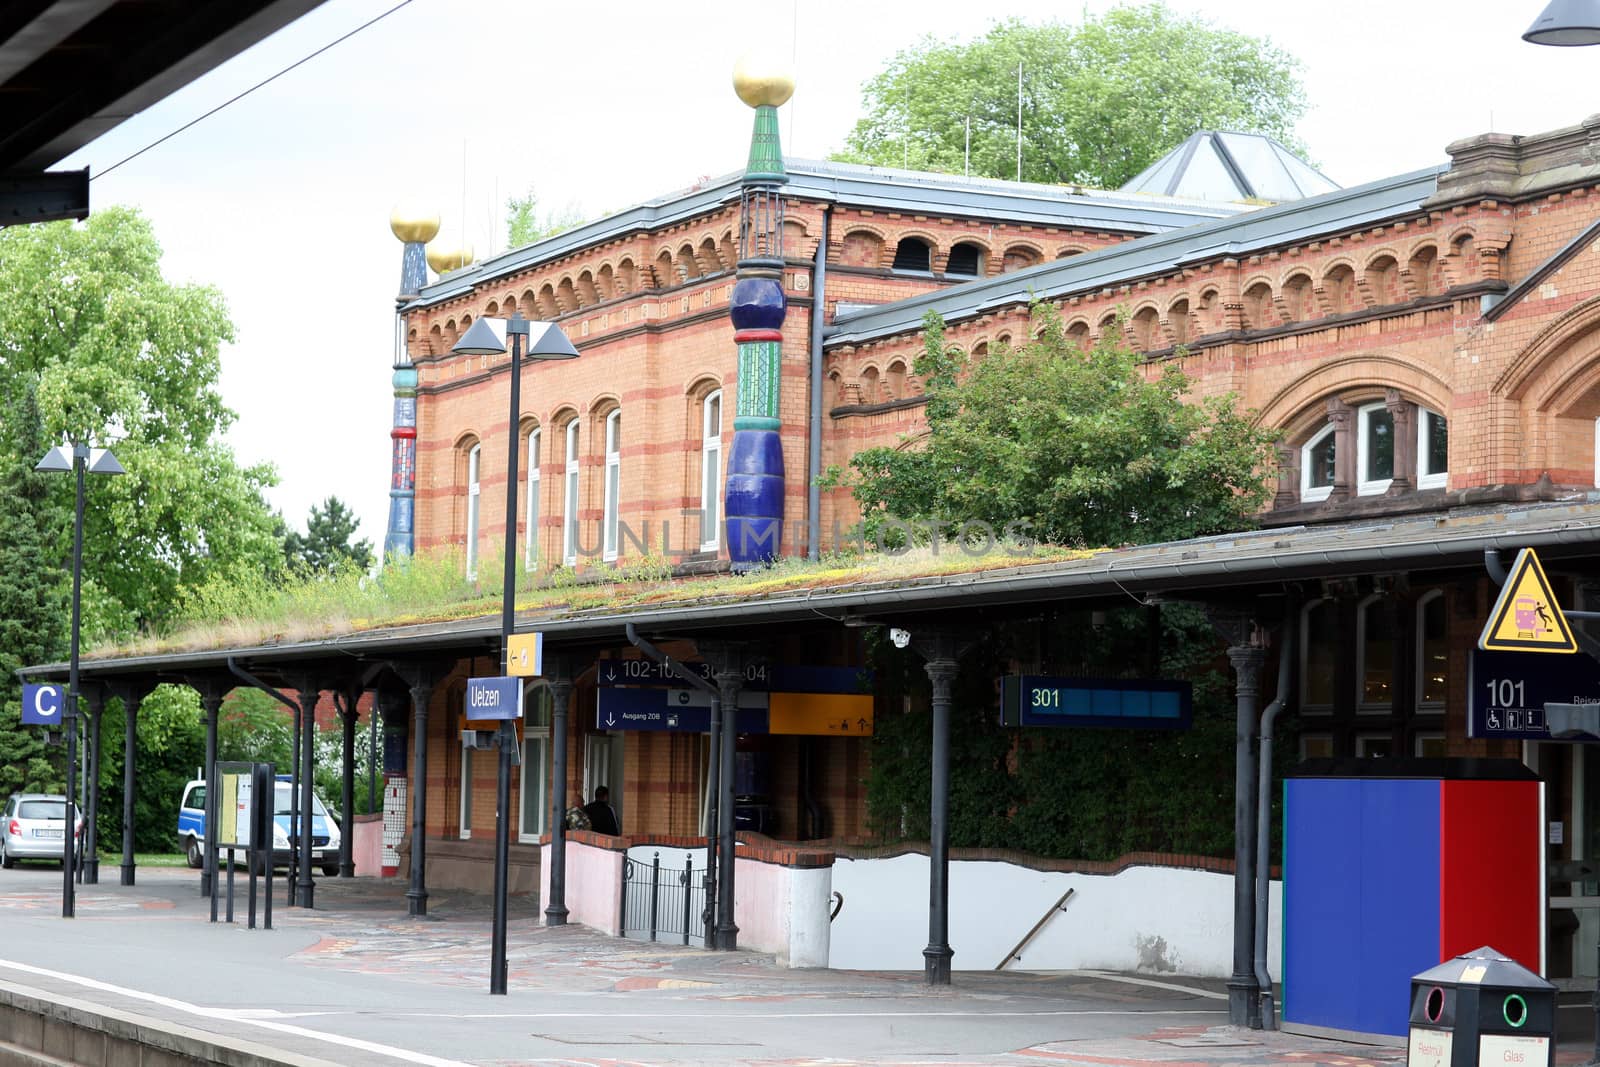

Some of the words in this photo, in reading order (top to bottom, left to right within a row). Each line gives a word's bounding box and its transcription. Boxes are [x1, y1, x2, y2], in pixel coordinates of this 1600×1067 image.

[35, 686, 57, 716] C
[471, 685, 500, 708] Uelzen
[1031, 688, 1060, 708] 301
[1486, 679, 1525, 708] 101
[622, 712, 647, 721] Ausgang
[1503, 1049, 1525, 1063] Glas
